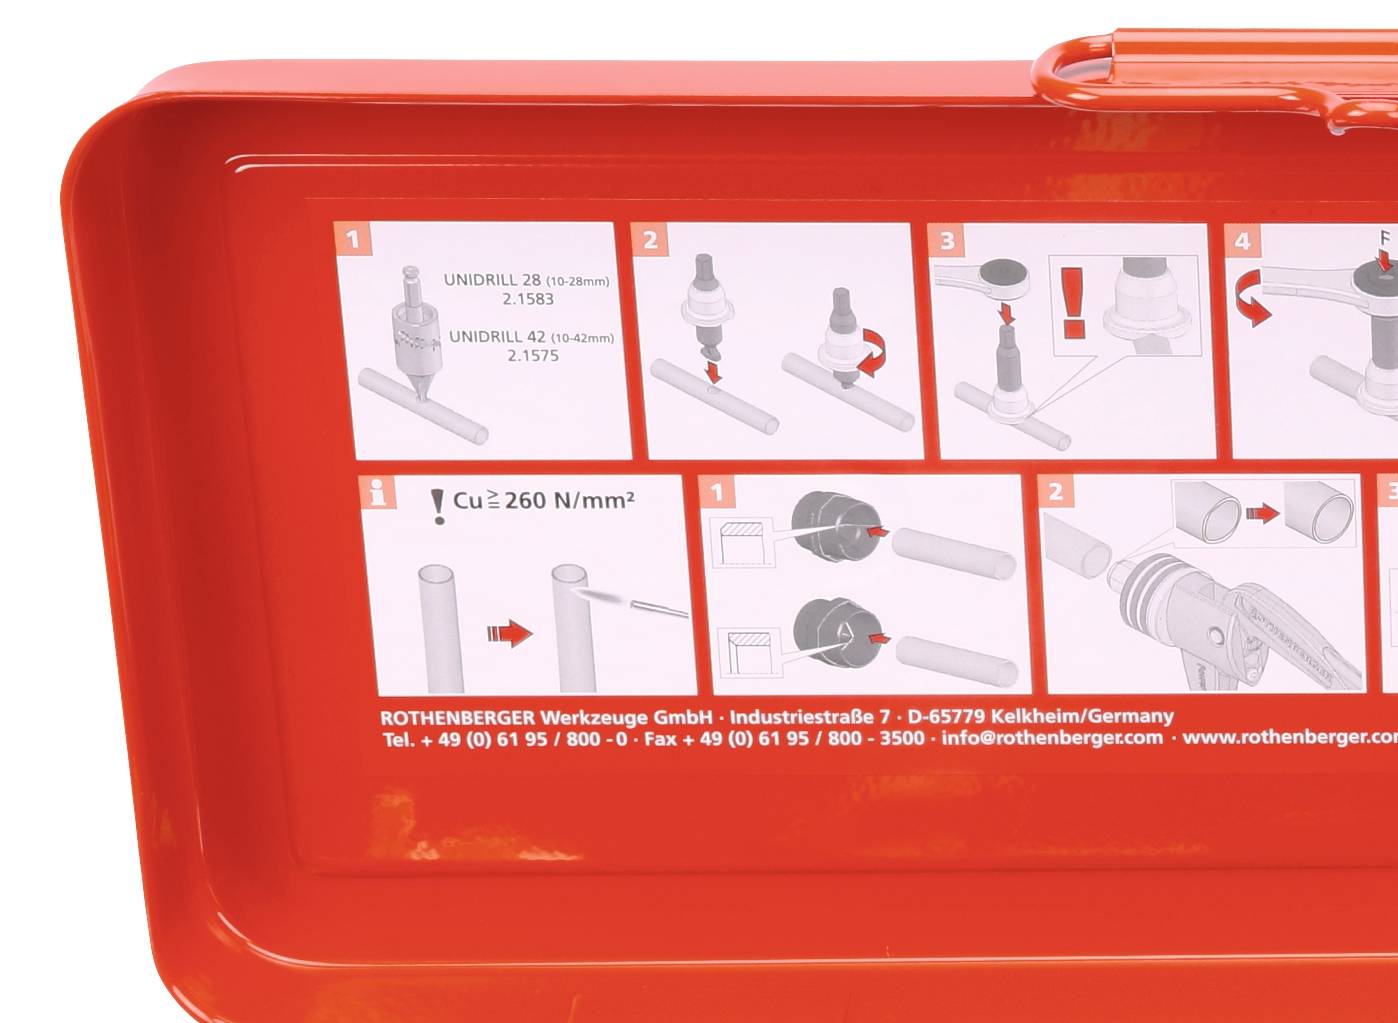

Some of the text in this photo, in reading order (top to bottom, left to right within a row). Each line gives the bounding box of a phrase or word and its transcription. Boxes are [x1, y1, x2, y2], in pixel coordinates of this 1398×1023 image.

[346, 230, 359, 250] 1
[643, 230, 659, 250] 2
[940, 231, 955, 250] 3
[1234, 232, 1251, 251] 4
[1380, 229, 1391, 246] F
[444, 273, 610, 288] UNIDRILL 28 (10-28mm)
[503, 292, 555, 306] 2.1583
[449, 330, 615, 345] UNIDRILL 42 (10-42mm)
[508, 349, 559, 362] 2.1575
[453, 491, 483, 509] Cu
[505, 491, 547, 509] 260
[710, 482, 723, 502] 1
[1048, 482, 1064, 501] 2
[381, 708, 1174, 727] ROTHENBERGER Werkzeuge GmbH Industriestraße 7 D-65779 Kelkheim/Germany
[382, 732, 415, 747] Tel.
[438, 732, 461, 747] 49
[466, 731, 492, 749] (0)
[497, 731, 518, 747] 61
[525, 731, 548, 747] 95
[566, 731, 601, 747] 800
[645, 732, 678, 747] Fax
[700, 731, 723, 746] 49
[728, 730, 753, 749] (0)
[758, 730, 780, 746] 61
[786, 730, 810, 746] 95
[828, 730, 862, 746] 800
[880, 730, 925, 746] 3500
[942, 730, 1164, 749] info@rothenberger.com
